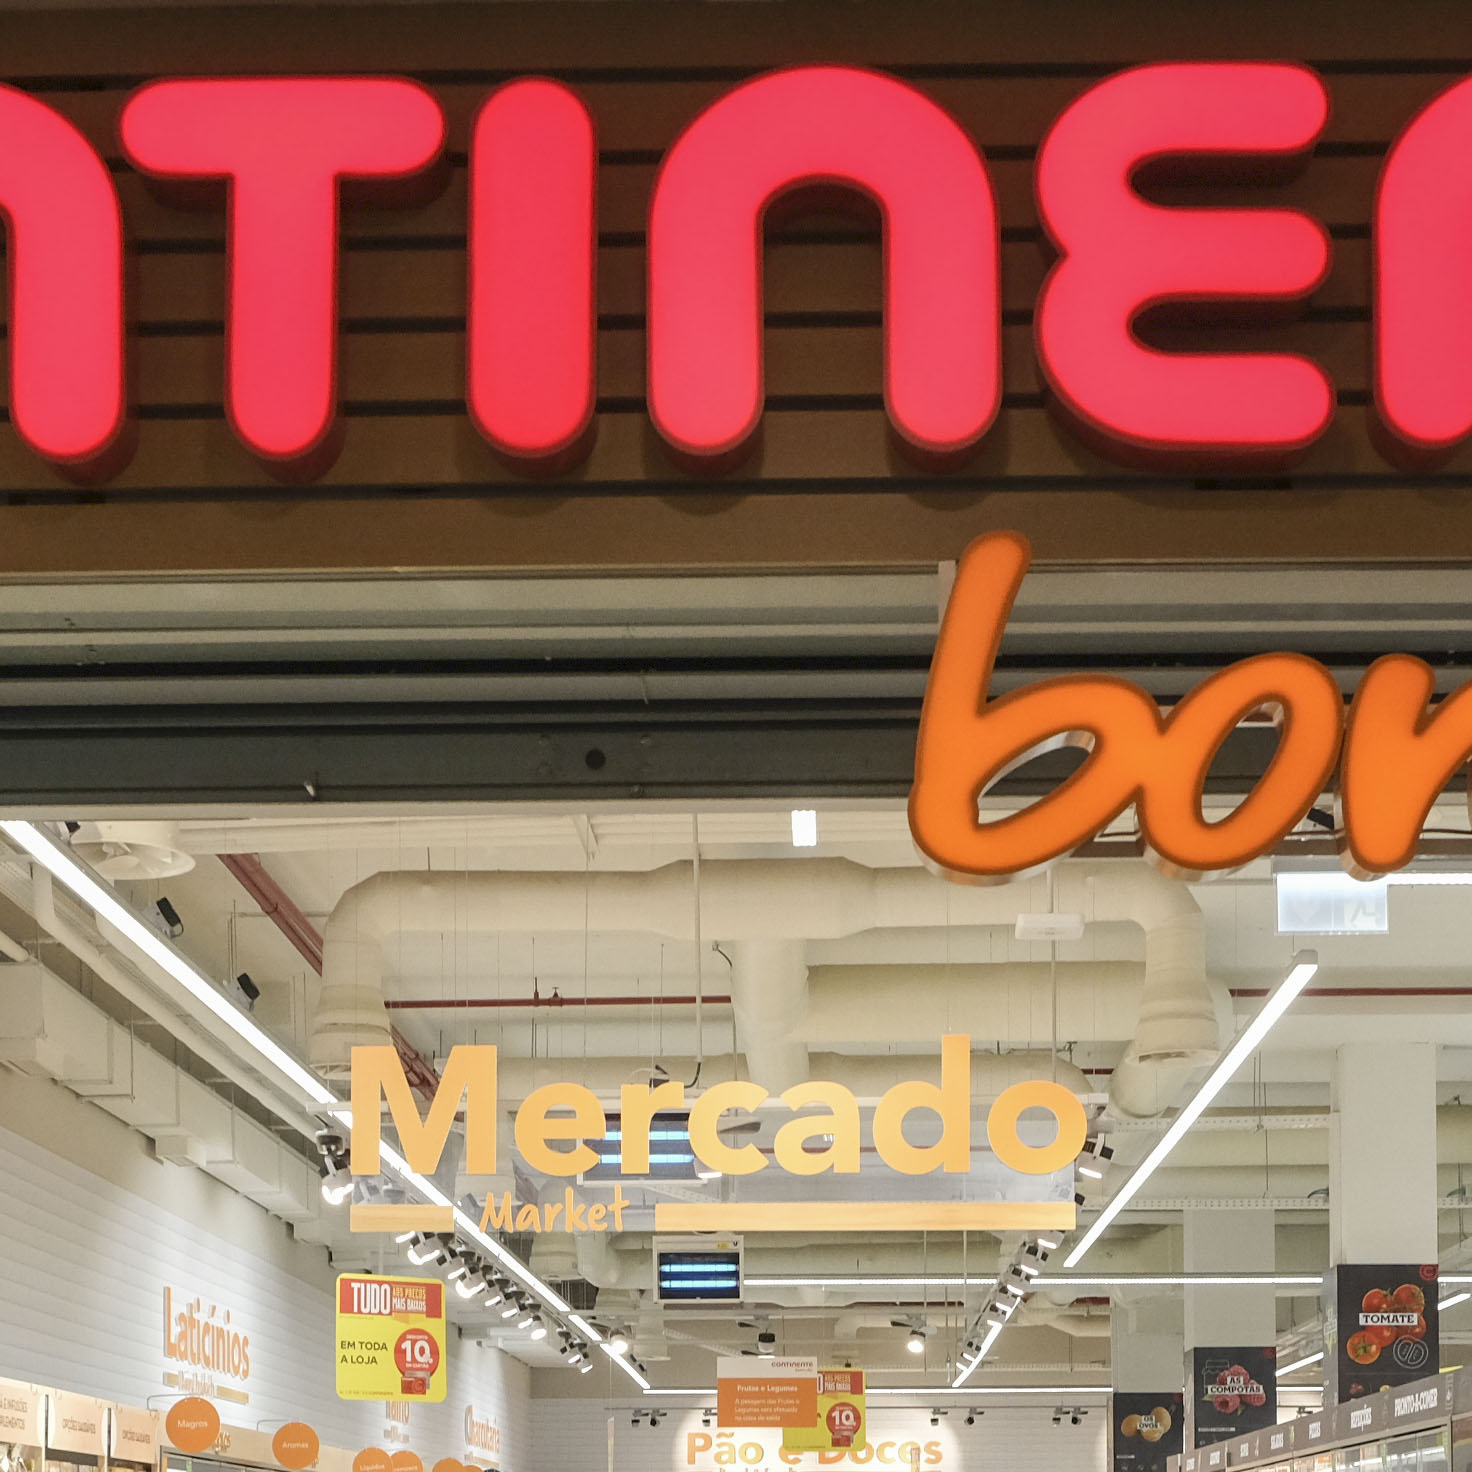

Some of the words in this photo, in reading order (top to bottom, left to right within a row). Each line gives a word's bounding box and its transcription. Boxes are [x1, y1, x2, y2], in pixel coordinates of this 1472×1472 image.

[350, 1034, 1088, 1176] Mercado
[479, 1185, 631, 1235] Market
[351, 1282, 391, 1315] TUDO
[392, 1298, 406, 1310] MAIS
[407, 1298, 427, 1312] BAIXOS
[1361, 1313, 1415, 1325] TOMATE
[163, 1287, 249, 1380] Laticínios
[340, 1340, 356, 1351] EM
[358, 1341, 389, 1352] TODA
[340, 1354, 348, 1365] A
[350, 1355, 378, 1366] LOJA
[1229, 1376, 1241, 1385] AS
[767, 1384, 798, 1394] Legumes
[1210, 1384, 1262, 1394] COMPOTAS
[178, 1419, 208, 1430] Magros
[687, 1432, 764, 1466] Pão
